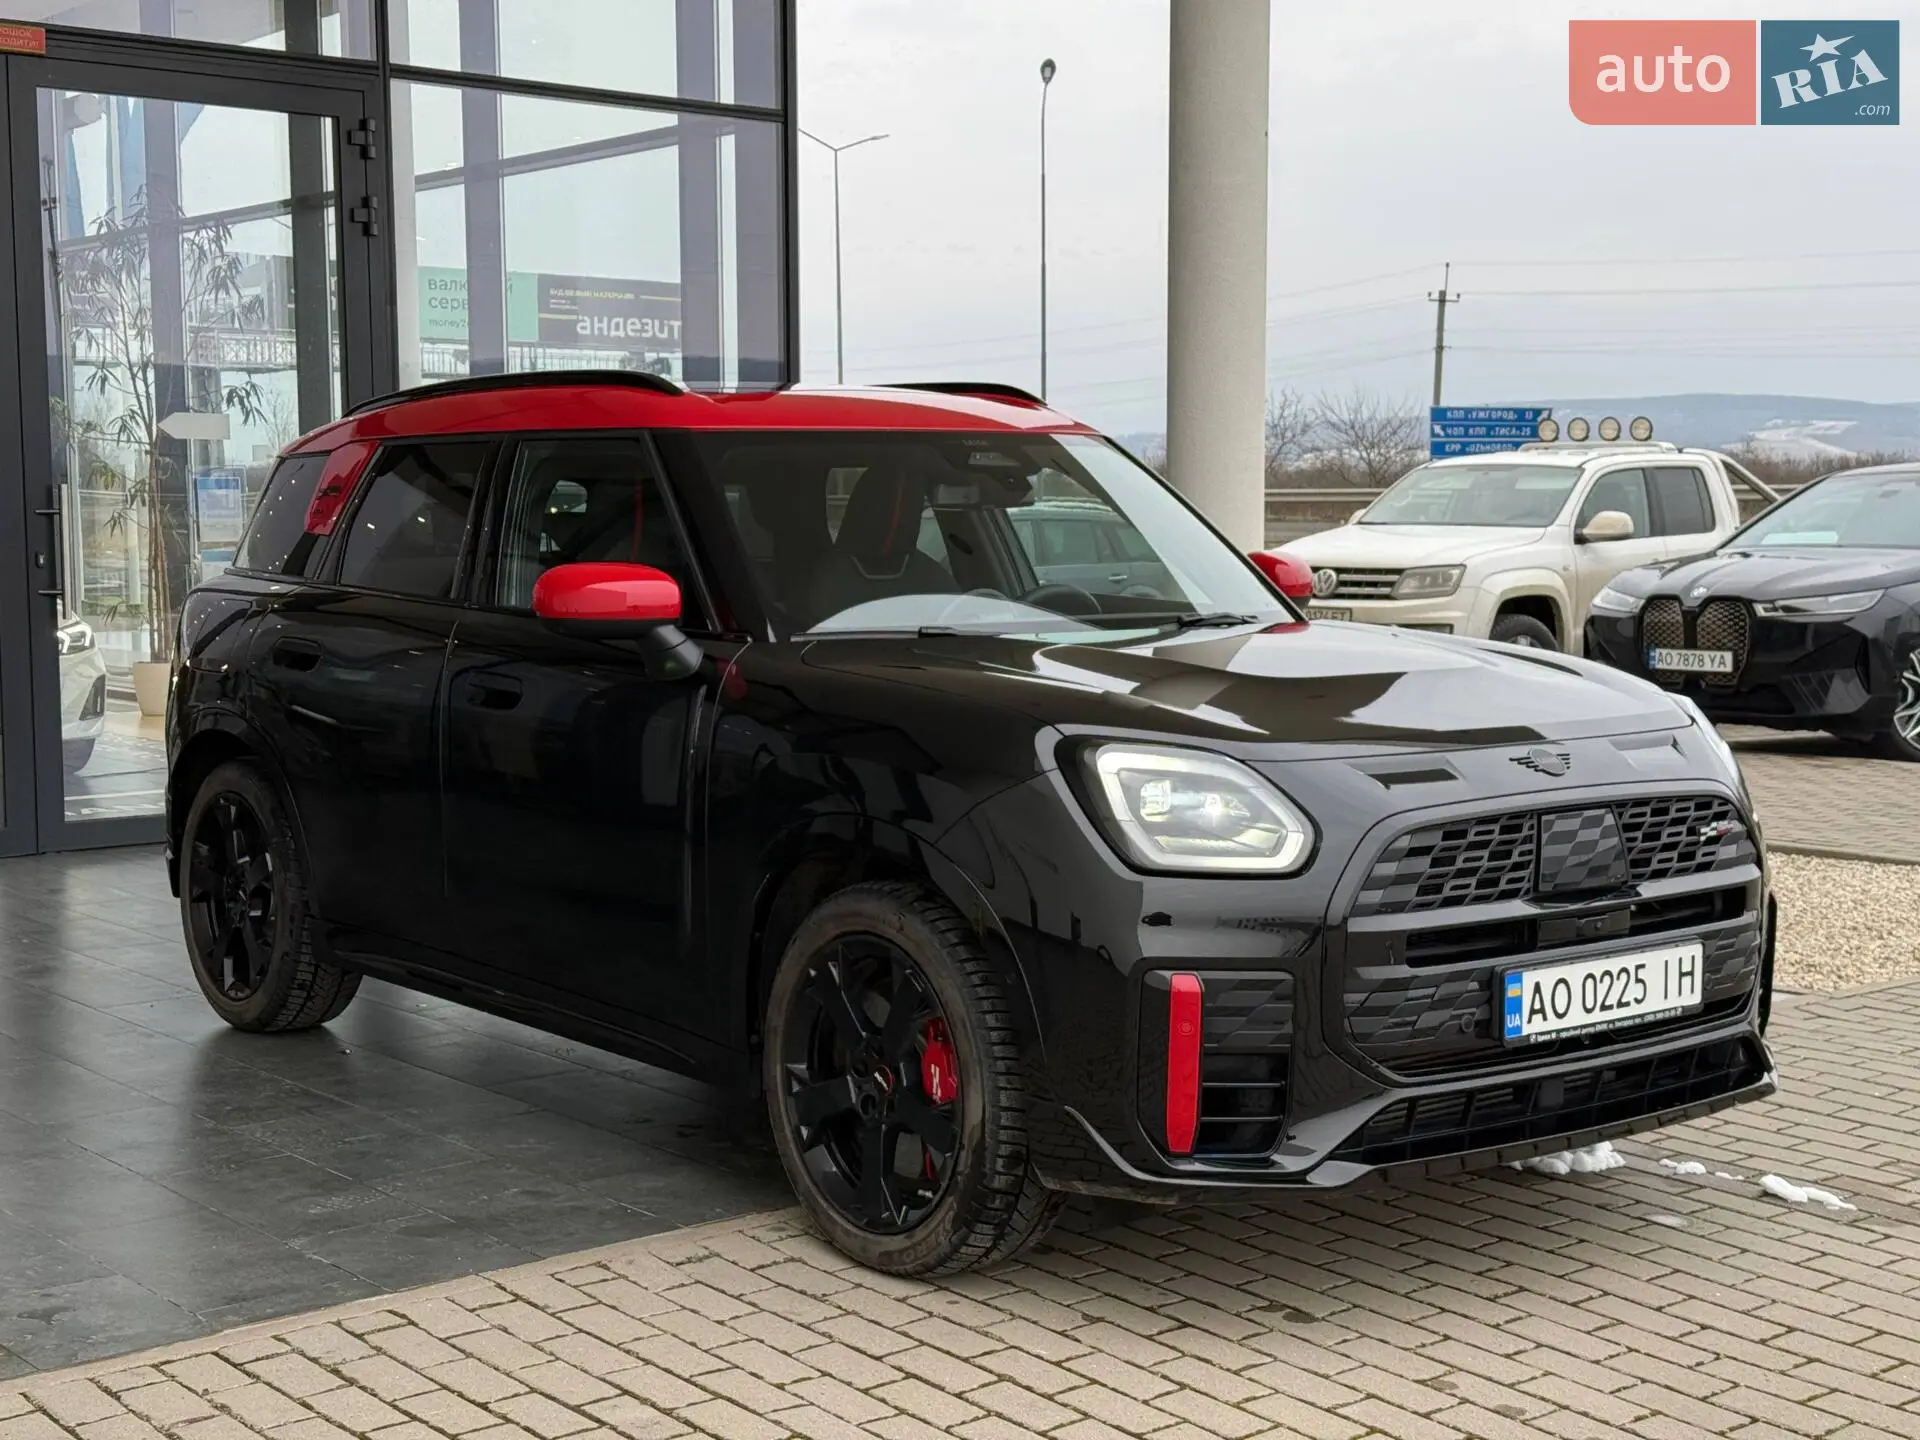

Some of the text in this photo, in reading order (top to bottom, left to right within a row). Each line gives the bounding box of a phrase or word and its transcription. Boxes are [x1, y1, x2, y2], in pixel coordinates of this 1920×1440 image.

[1656, 652, 1727, 668] AO 7878 YA
[1527, 954, 1696, 1024] AO 0225 IH
[1506, 1014, 1522, 1029] UA
